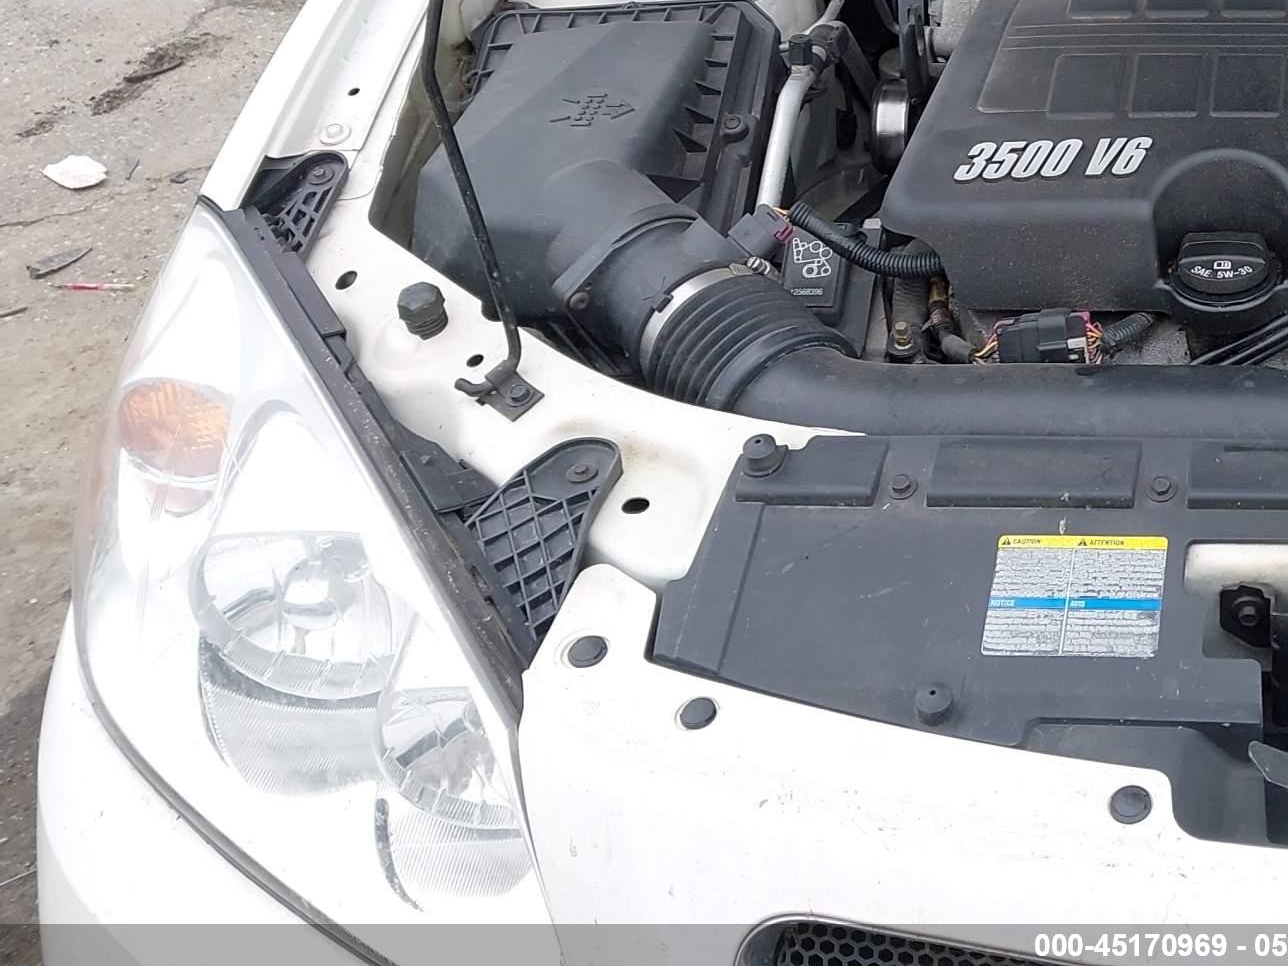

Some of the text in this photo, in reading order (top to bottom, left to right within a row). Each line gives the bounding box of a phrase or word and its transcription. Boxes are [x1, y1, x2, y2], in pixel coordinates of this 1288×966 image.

[953, 136, 1153, 181] 3500 V6
[1190, 265, 1253, 279] SAE 5W-30
[990, 599, 1016, 607] NOTICE
